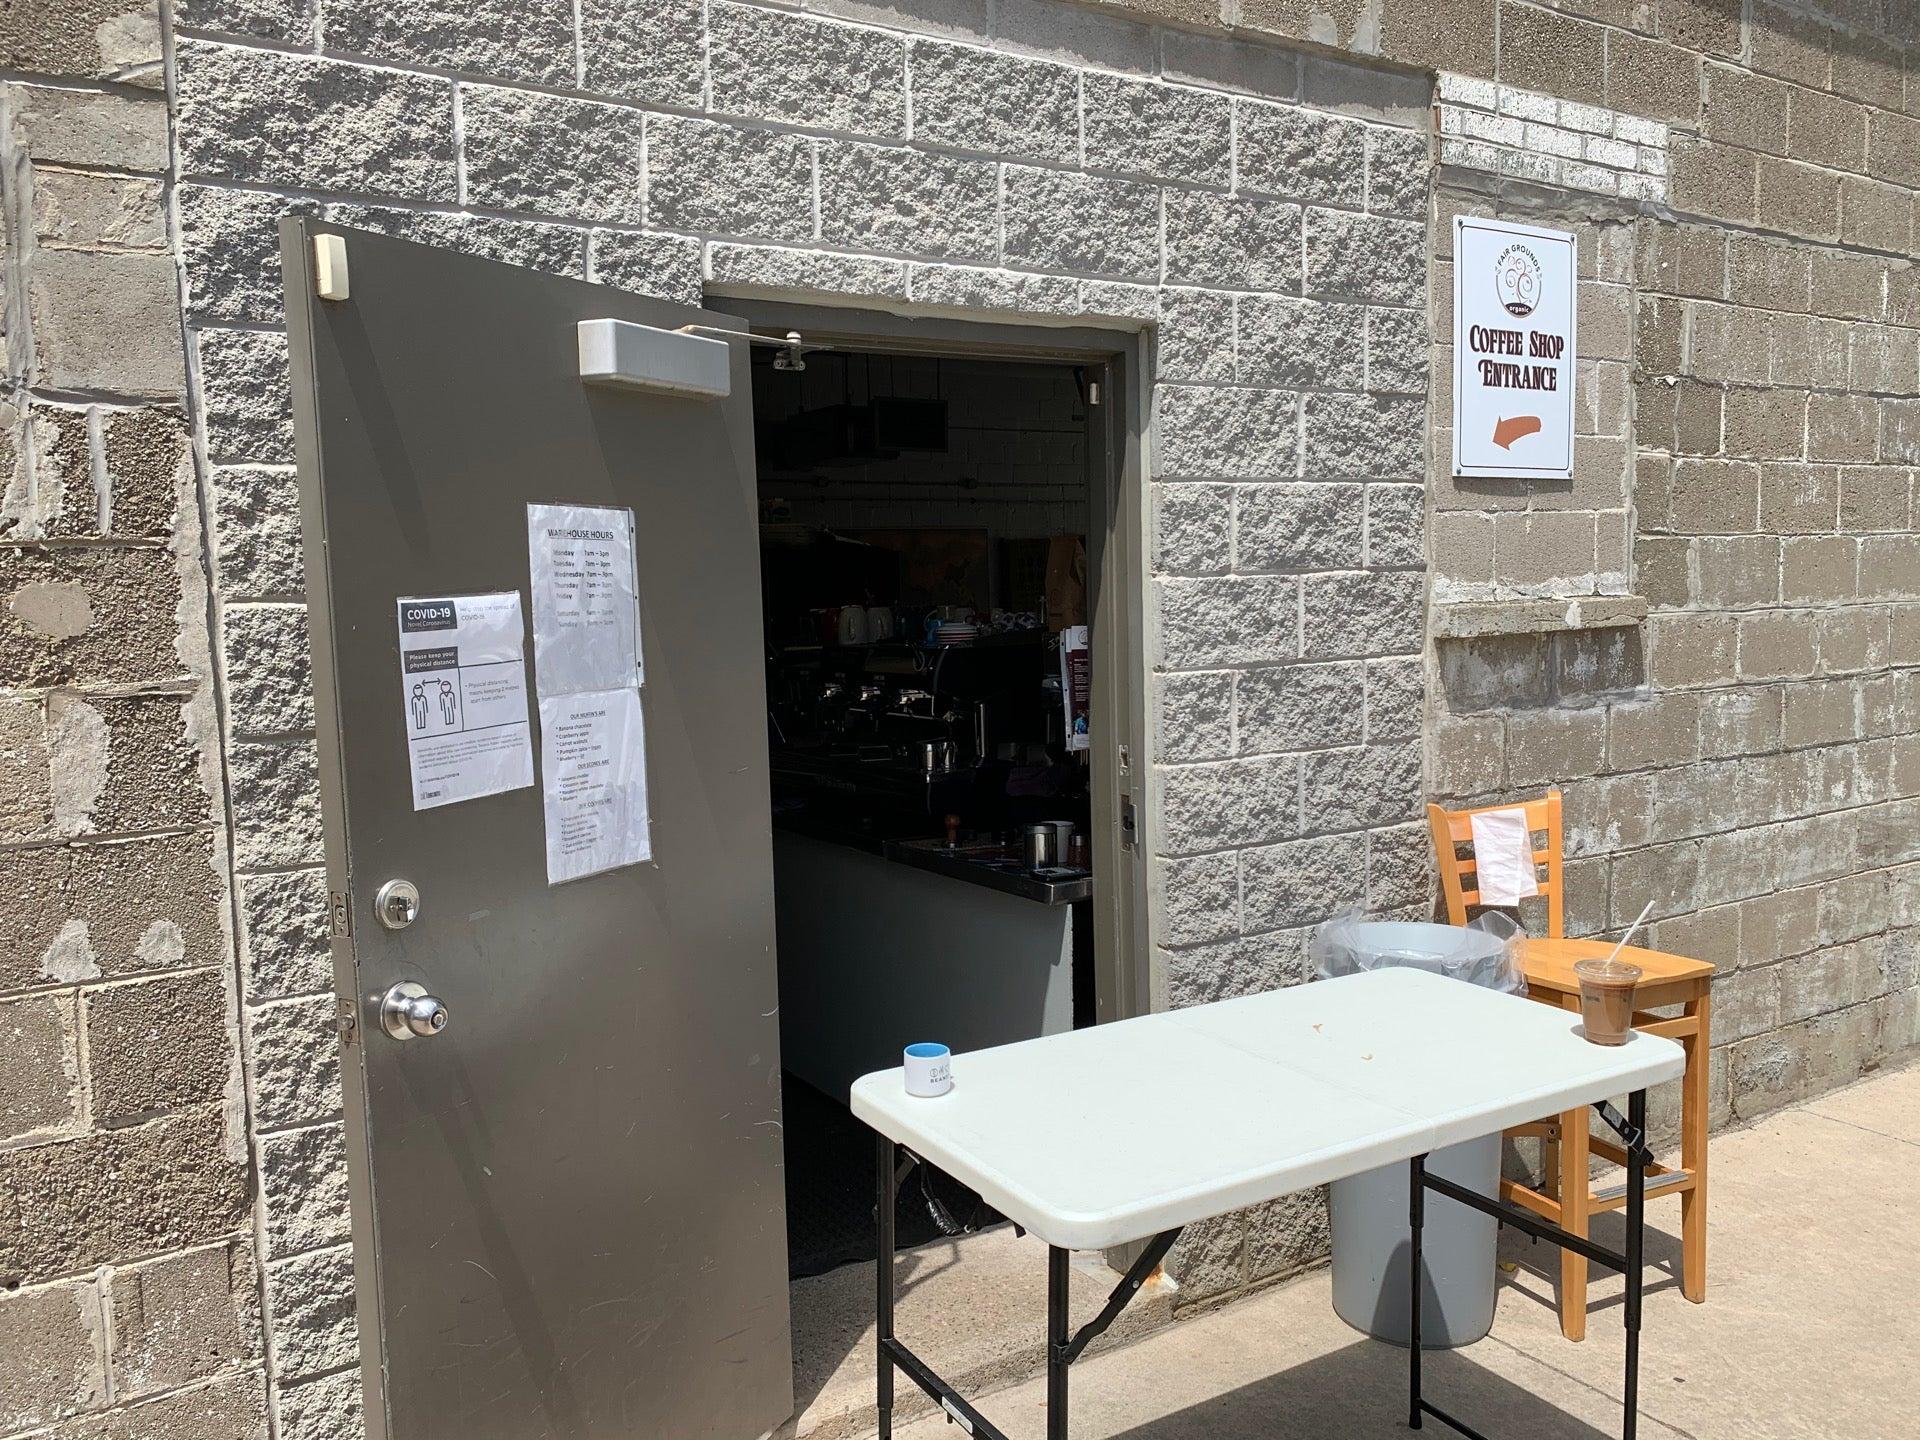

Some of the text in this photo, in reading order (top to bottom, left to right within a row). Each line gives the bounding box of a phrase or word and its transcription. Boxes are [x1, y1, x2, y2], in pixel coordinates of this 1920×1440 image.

[1497, 244, 1541, 273] FAIR GROUNDS
[1509, 305, 1530, 315] organic
[1469, 324, 1565, 360] COFFEE SHOP
[1478, 359, 1557, 392] ENTRANCE
[548, 528, 614, 540] WAREHOUSE HOURS
[407, 607, 451, 620] COVID-19
[407, 620, 421, 628] Novel
[409, 659, 456, 670] physical distance
